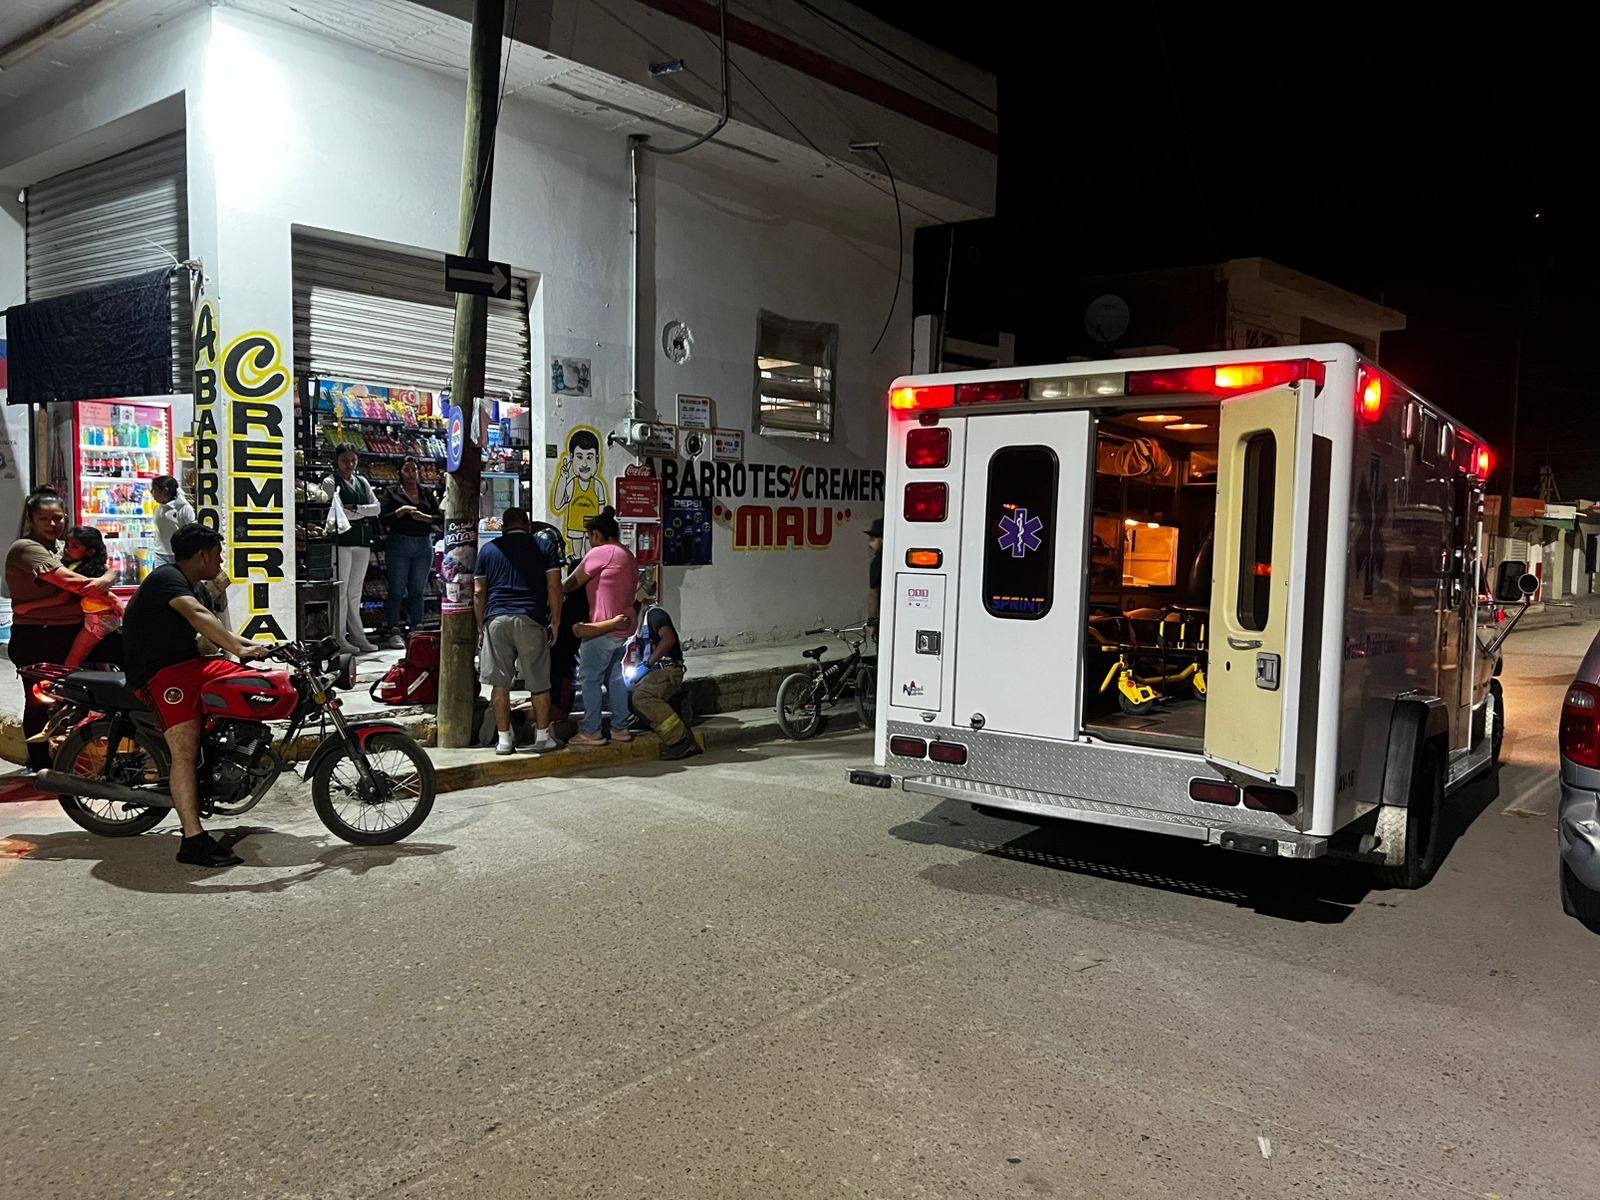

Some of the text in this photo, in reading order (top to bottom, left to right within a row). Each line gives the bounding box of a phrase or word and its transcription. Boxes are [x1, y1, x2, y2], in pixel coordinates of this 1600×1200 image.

[223, 336, 289, 641] CREMERIA
[735, 505, 832, 547] MAU
[907, 588, 929, 597] 911
